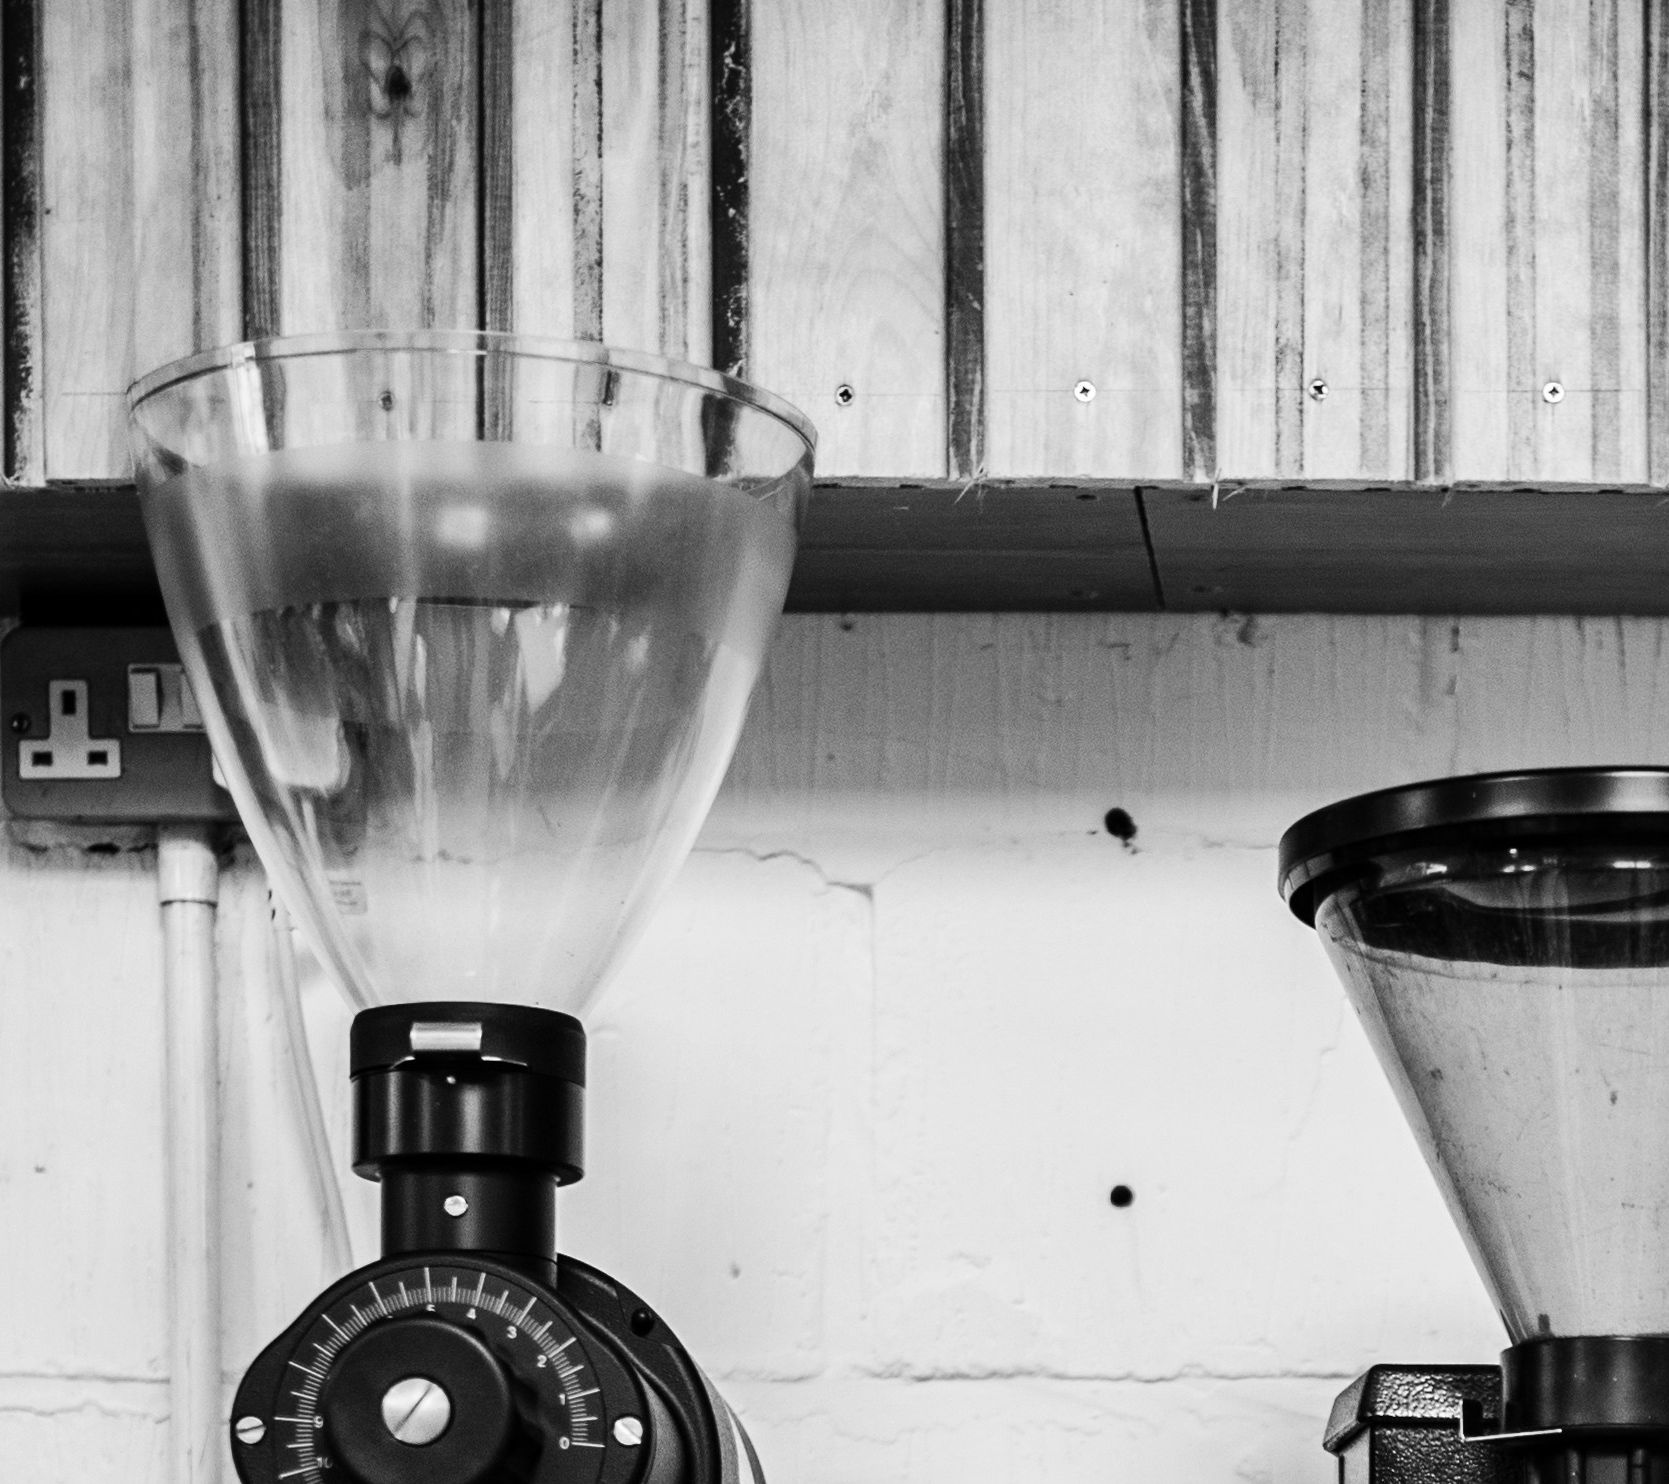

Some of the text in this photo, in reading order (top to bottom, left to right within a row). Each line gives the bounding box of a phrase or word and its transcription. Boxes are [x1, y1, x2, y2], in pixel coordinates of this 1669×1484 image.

[466, 1308, 477, 1319] 4
[506, 1326, 517, 1338] 3
[537, 1355, 547, 1367] 2
[314, 1415, 323, 1427] 9
[558, 1437, 569, 1449] 0
